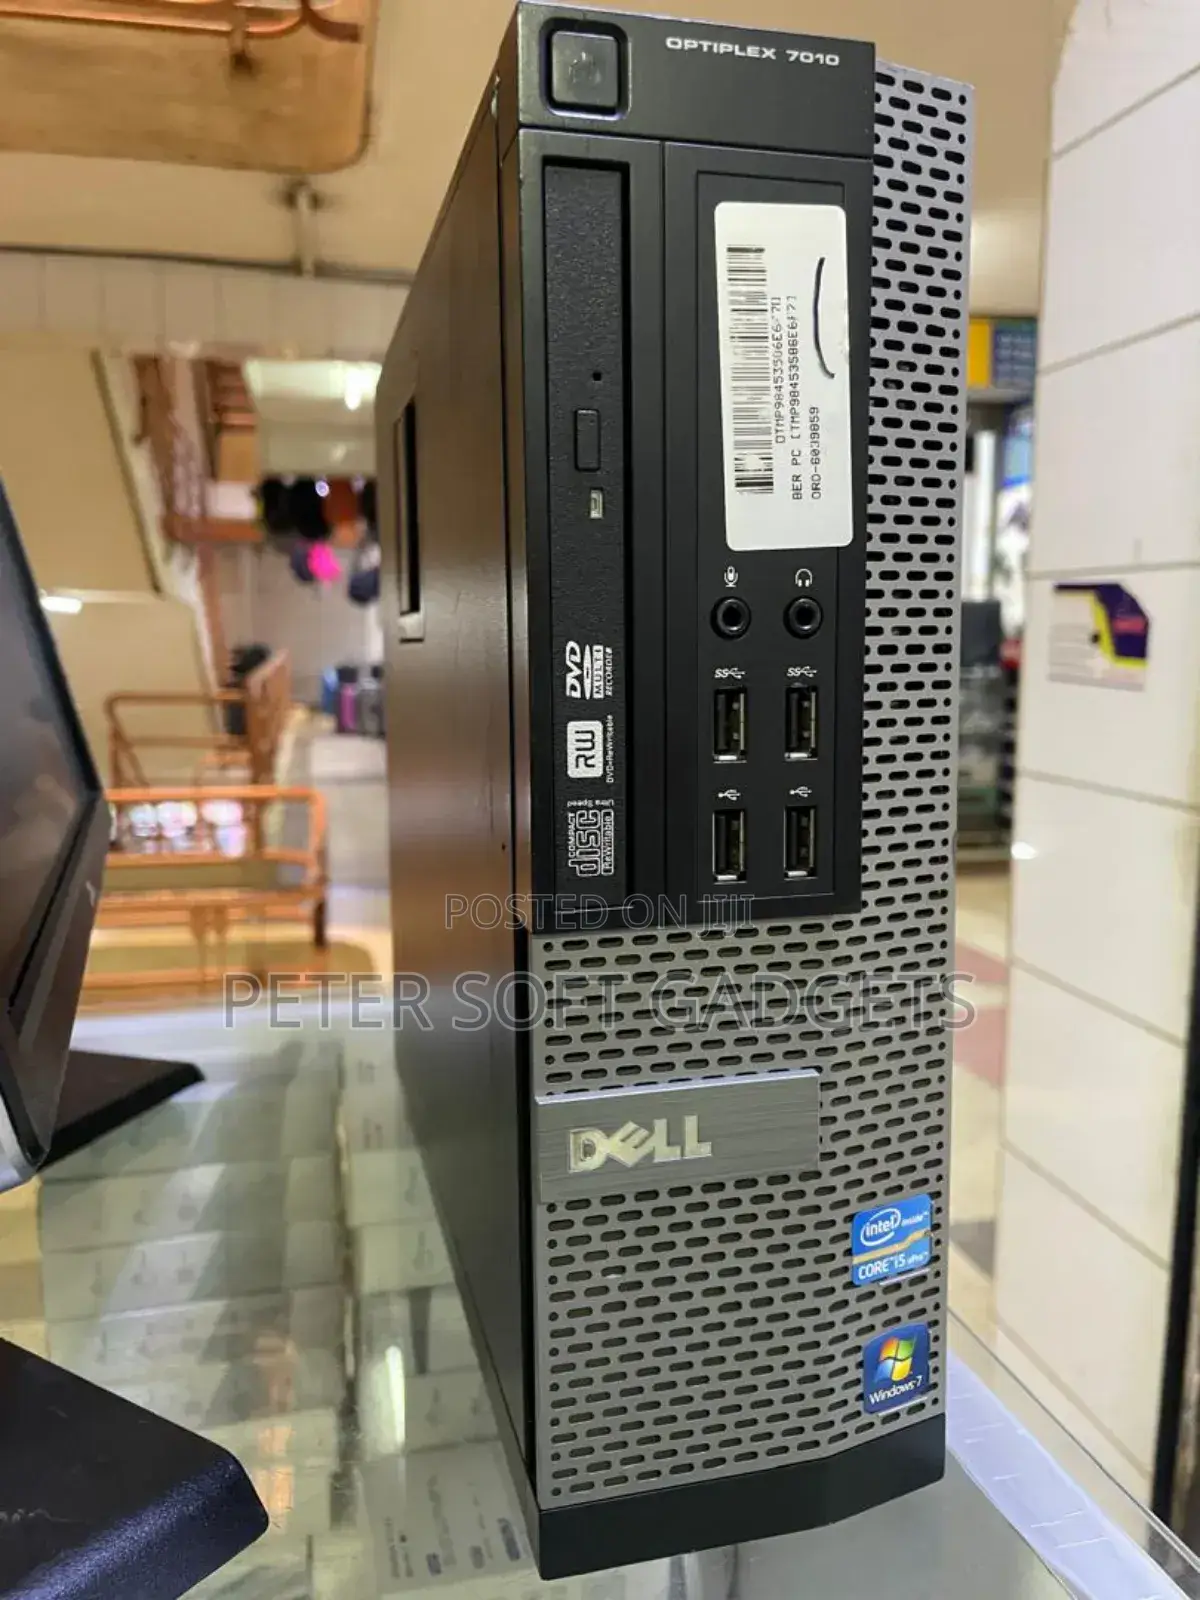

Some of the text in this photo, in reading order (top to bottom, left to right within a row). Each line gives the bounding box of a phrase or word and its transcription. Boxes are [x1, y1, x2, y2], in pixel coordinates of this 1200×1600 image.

[665, 36, 840, 66] OPTIPLEX 7010
[790, 449, 802, 466] PC
[566, 640, 582, 698] DVD
[594, 647, 603, 696] MULTI
[574, 729, 596, 769] RW
[567, 811, 576, 858] COMPACT
[569, 1115, 712, 1173] DELL
[864, 1212, 898, 1239] intel
[869, 1380, 915, 1405] Windows
